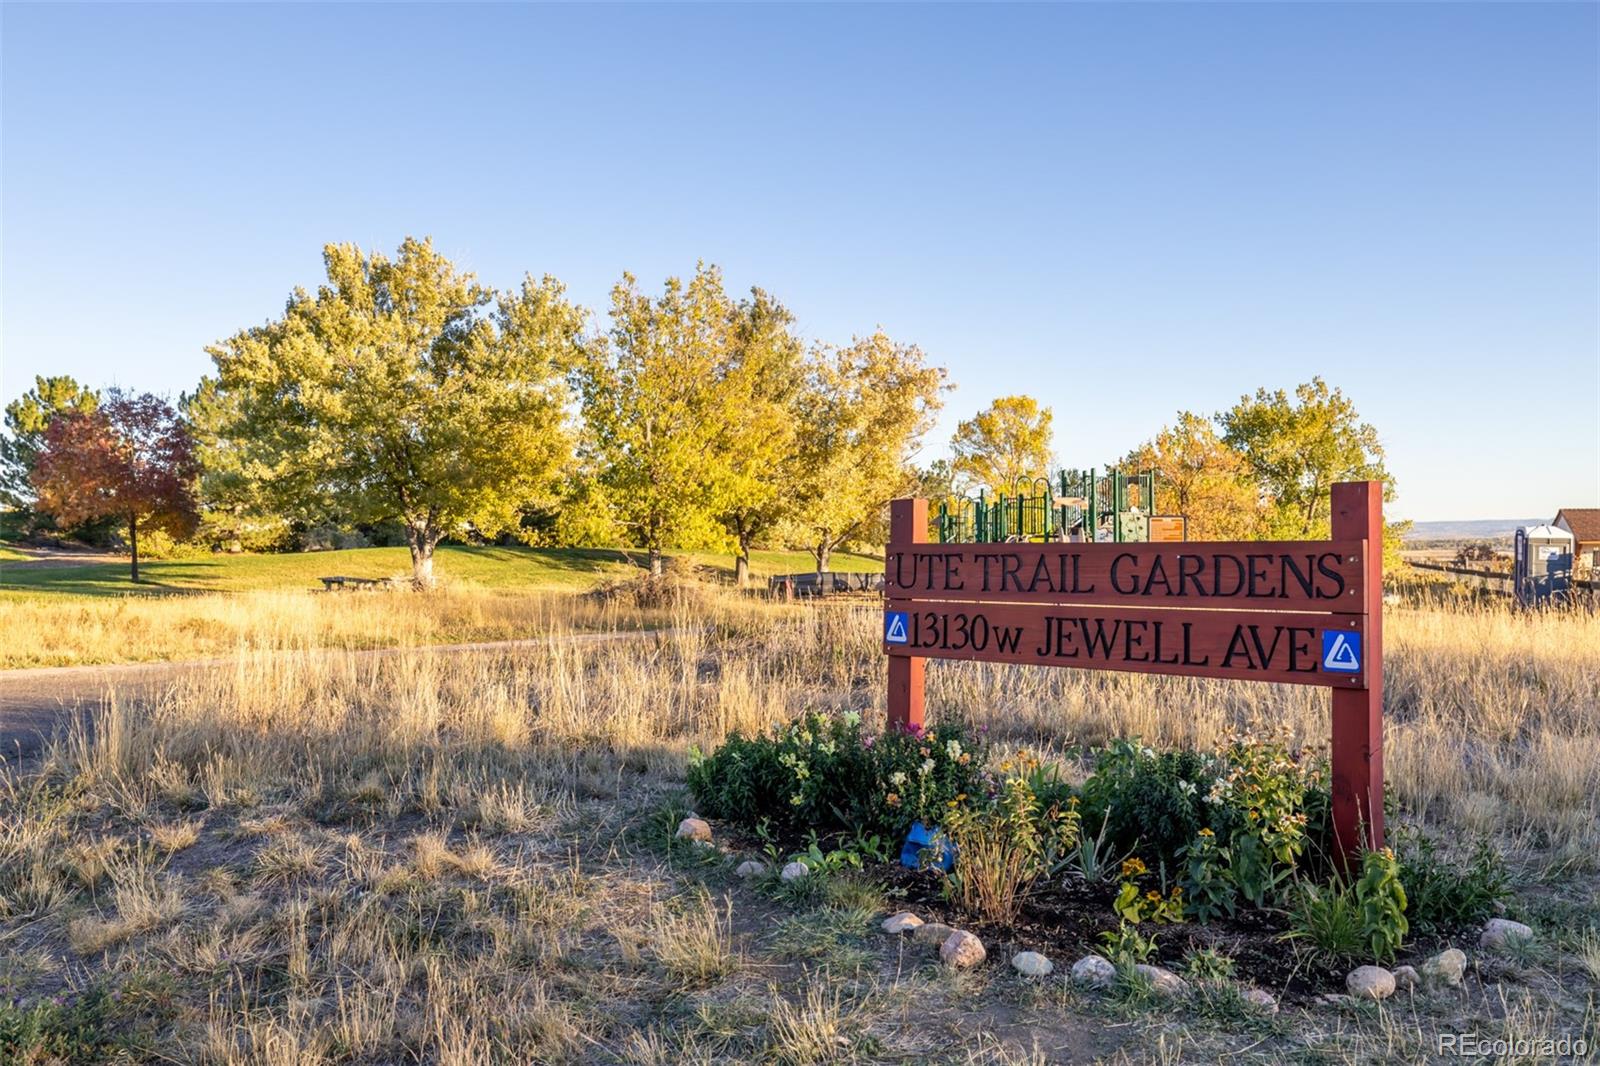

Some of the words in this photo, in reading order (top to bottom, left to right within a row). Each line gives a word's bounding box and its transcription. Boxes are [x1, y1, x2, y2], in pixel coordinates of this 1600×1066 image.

[896, 552, 964, 590] UTE
[974, 553, 1095, 593] TRAIL
[1110, 553, 1345, 599] GARDENS
[910, 612, 989, 651] 13130
[1037, 616, 1209, 665] JEWELL
[1221, 624, 1318, 672] AVE
